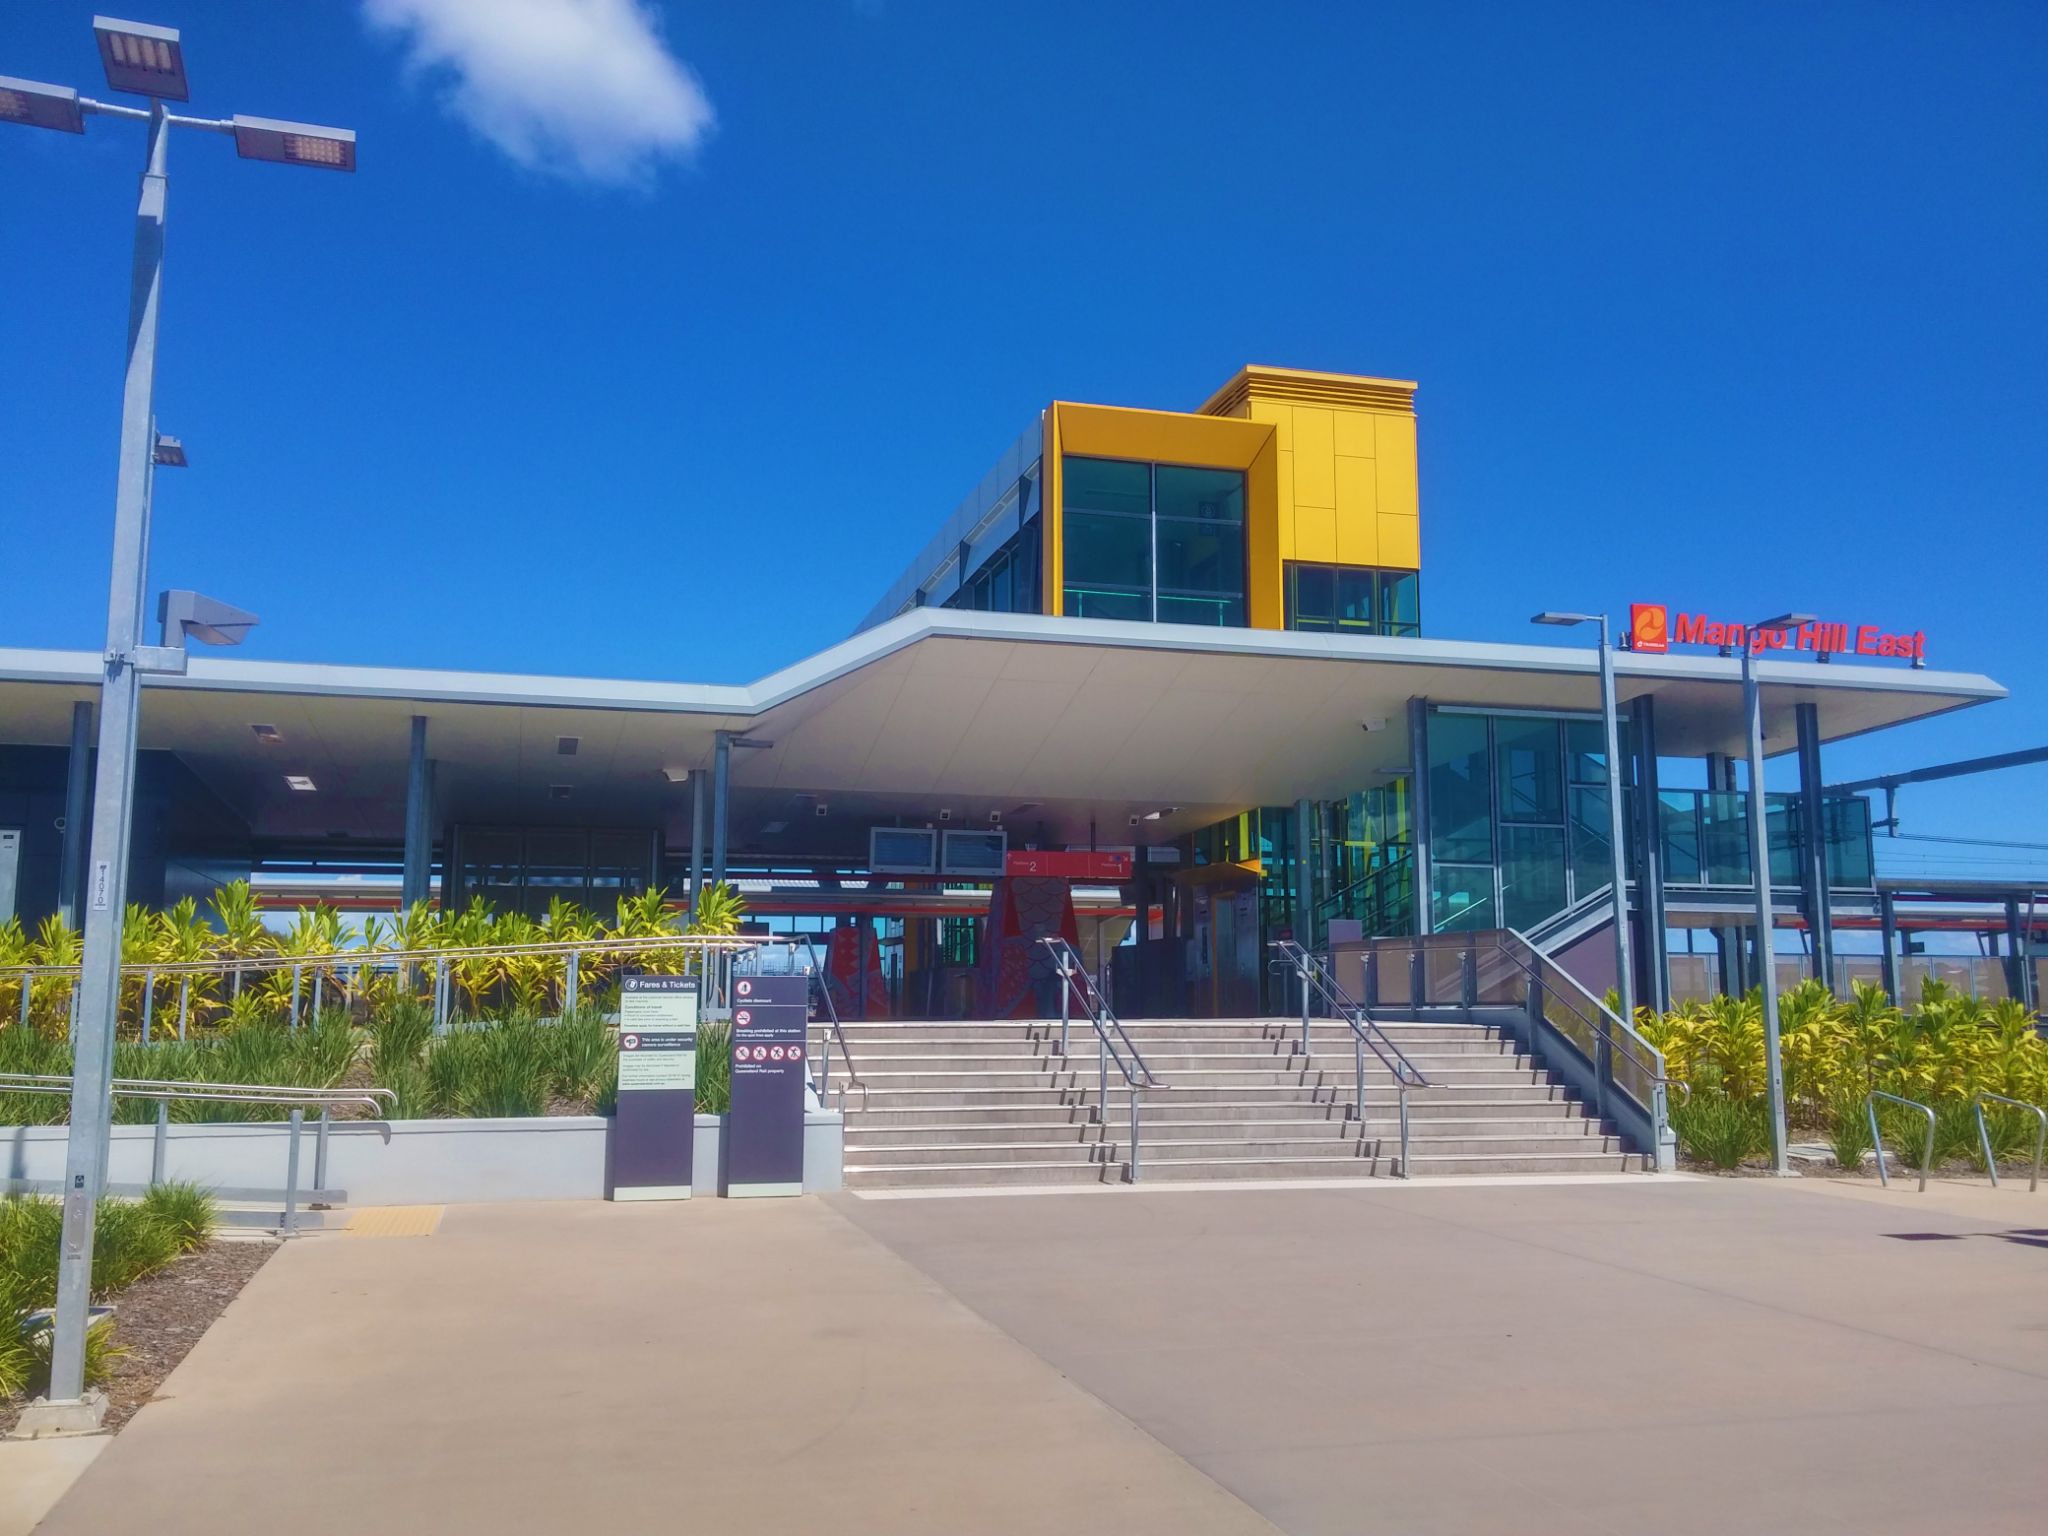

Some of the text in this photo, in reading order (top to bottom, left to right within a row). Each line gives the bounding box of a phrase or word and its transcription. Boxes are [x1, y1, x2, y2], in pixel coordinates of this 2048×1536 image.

[1674, 612, 1926, 657] Mango Hill East
[1029, 861, 1037, 872] 2
[639, 981, 696, 989] Fares & Tickets
